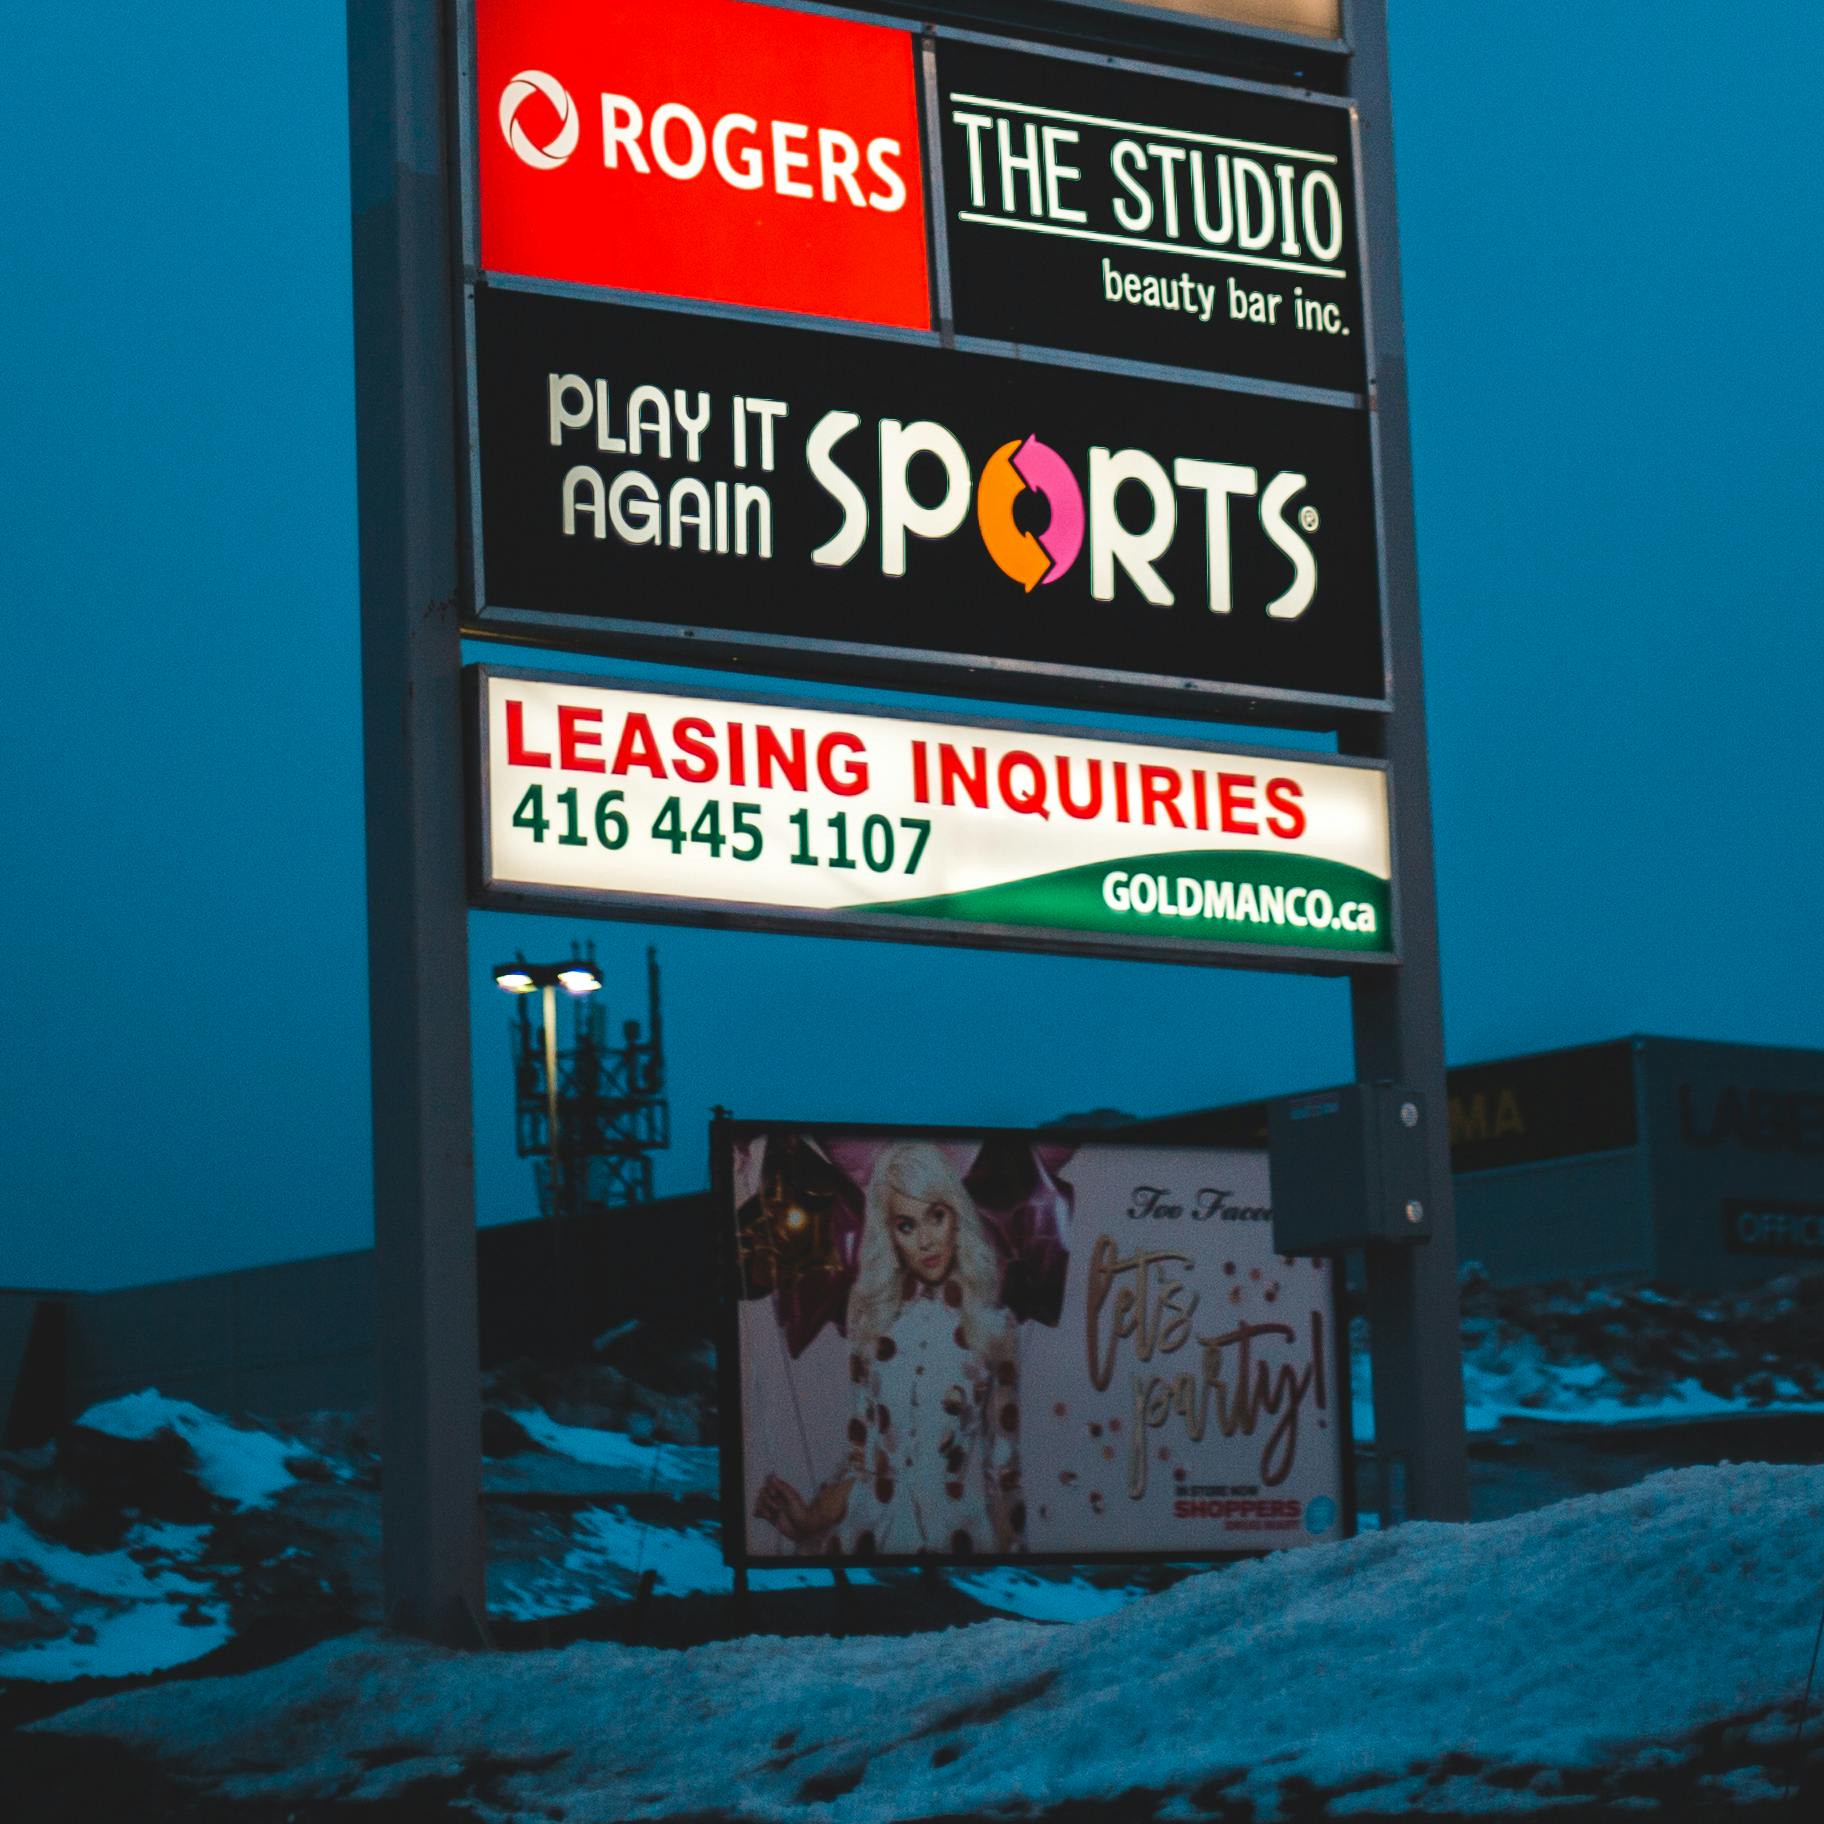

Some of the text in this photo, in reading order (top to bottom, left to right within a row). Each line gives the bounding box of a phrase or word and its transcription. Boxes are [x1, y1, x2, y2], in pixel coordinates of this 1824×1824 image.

[600, 91, 908, 213] ROGERS
[952, 110, 1344, 263] THE STUDIO
[1102, 258, 1351, 336] beauty bar inc.
[547, 372, 789, 472] PLAY IT
[563, 465, 774, 559] AGAIN
[504, 699, 1308, 840] LEASING INQUIRIES
[511, 783, 933, 876] 416 445 1107
[1102, 870, 1378, 934] GOLDMANCO.ca
[1126, 1185, 1184, 1220] Too
[1175, 1500, 1301, 1519] SHOPPERS
